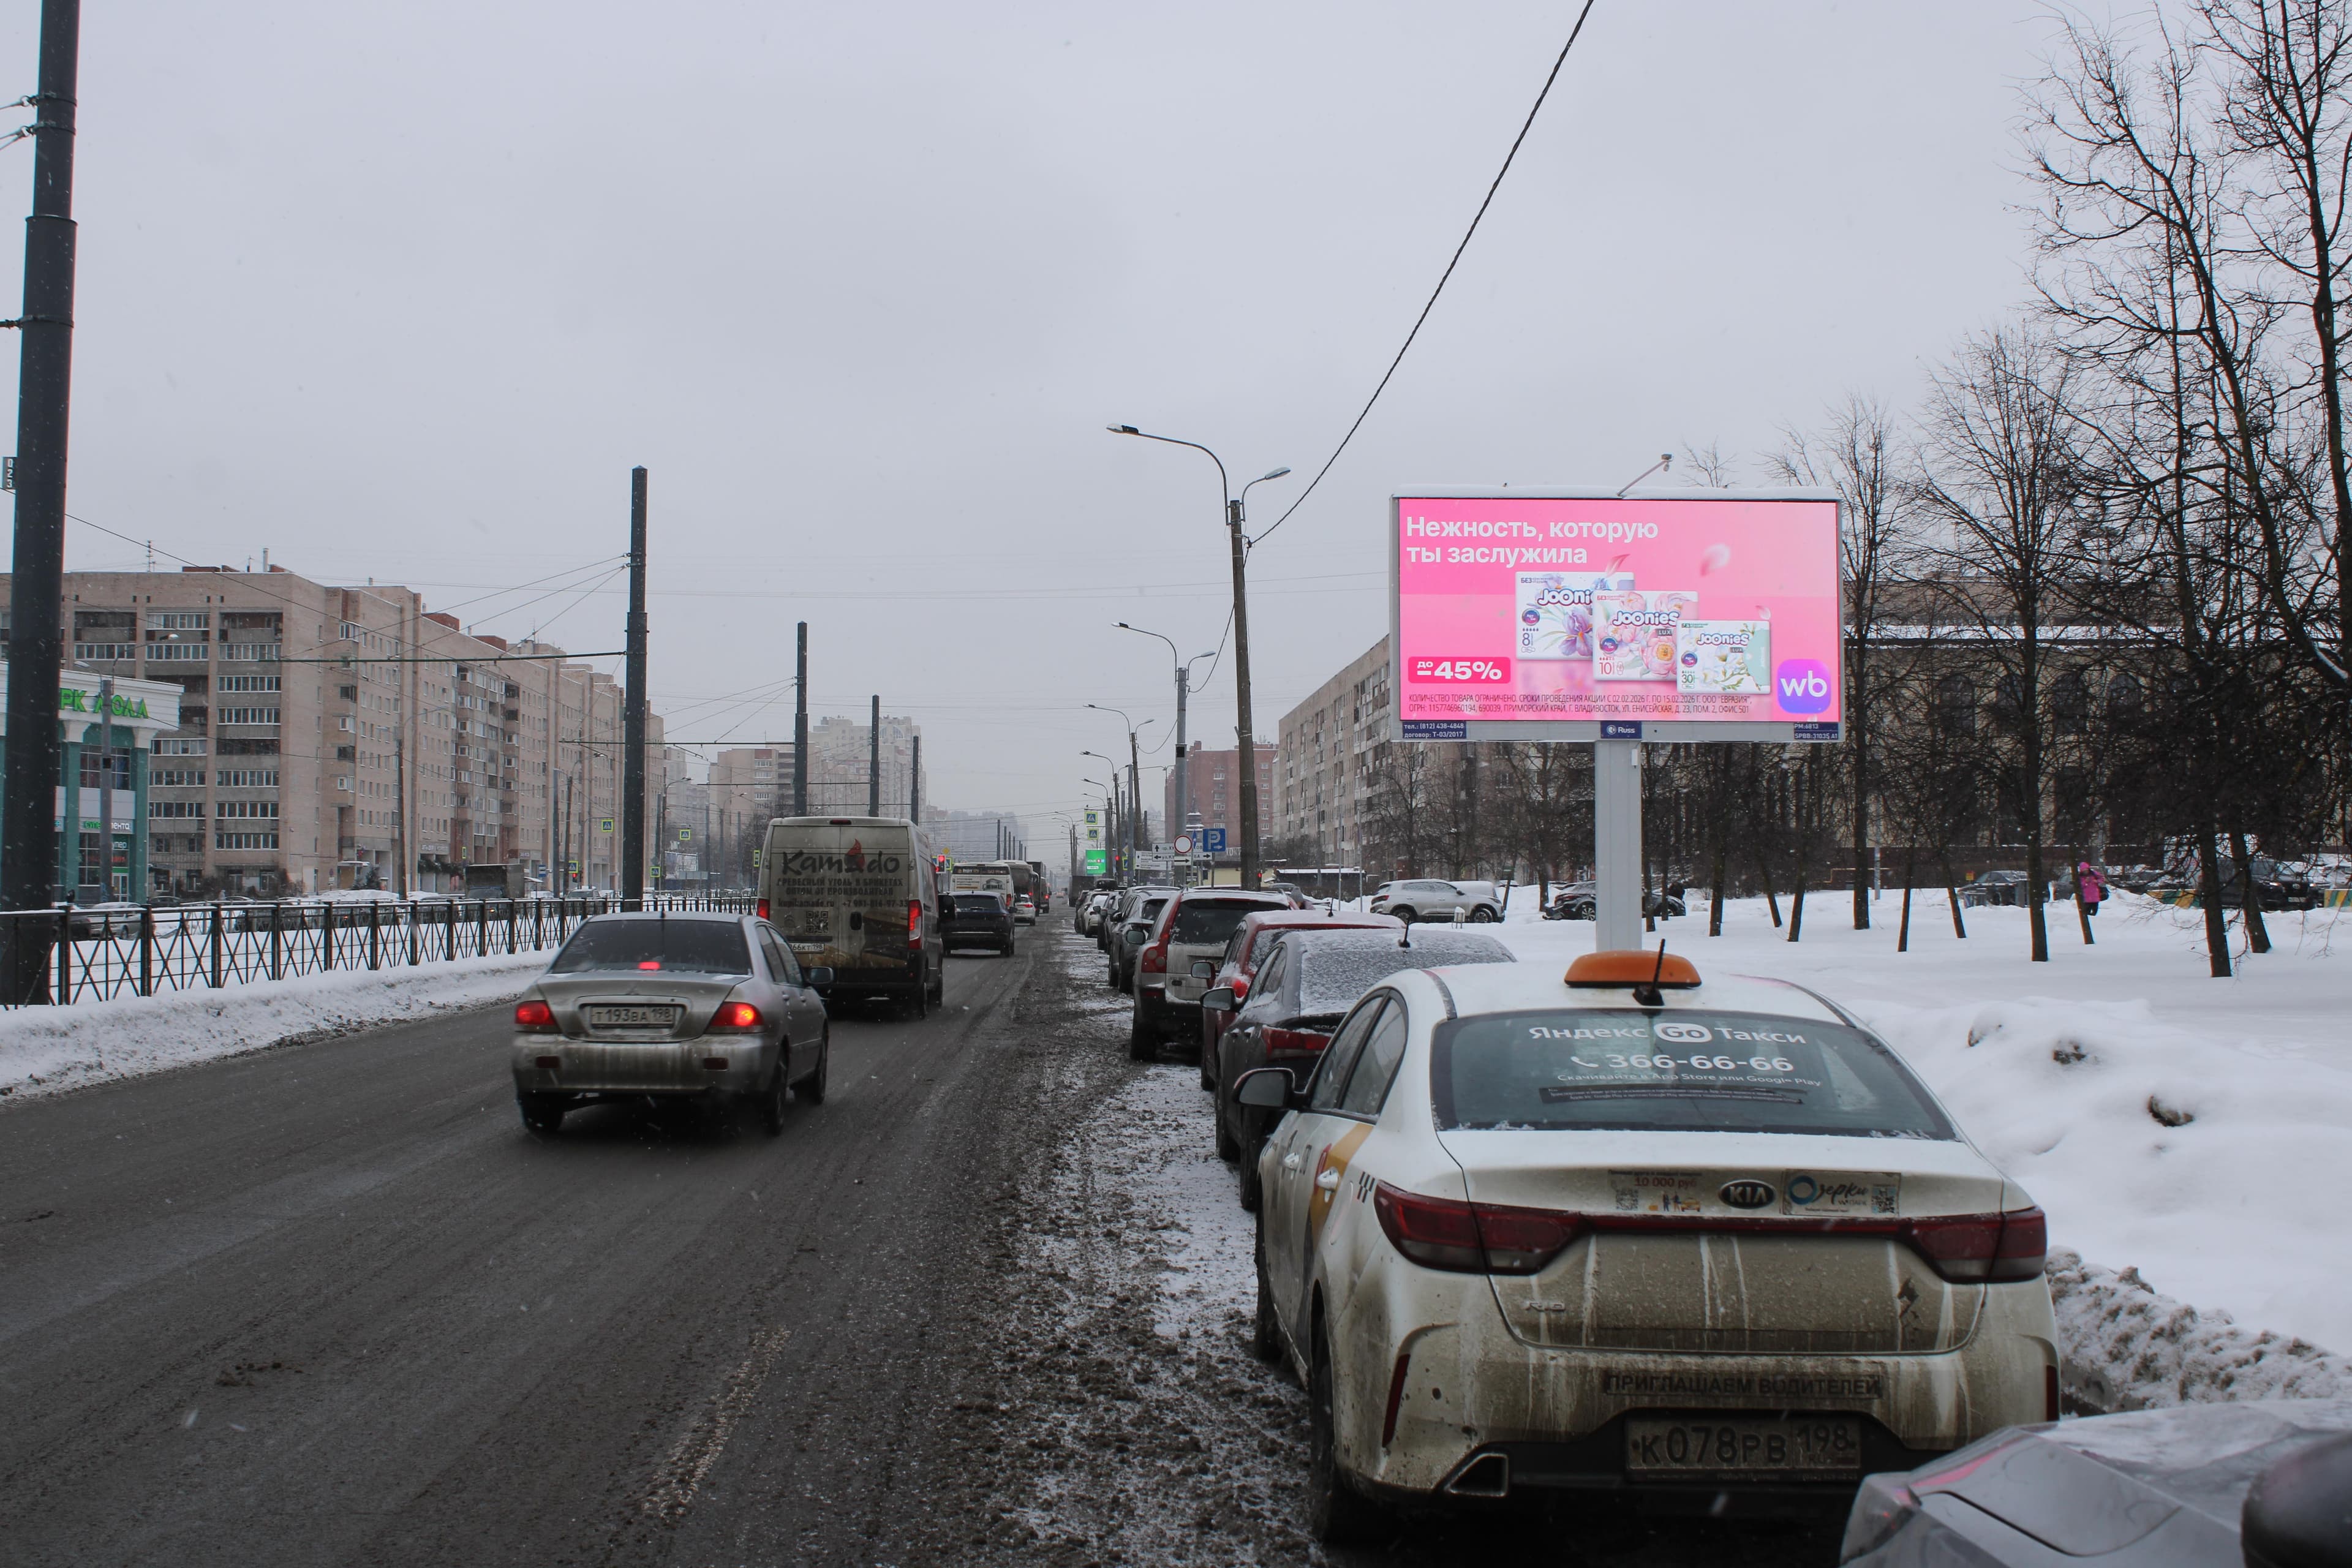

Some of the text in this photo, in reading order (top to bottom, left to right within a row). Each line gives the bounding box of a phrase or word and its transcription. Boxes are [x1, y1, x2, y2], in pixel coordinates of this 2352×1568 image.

[1406, 516, 1658, 543] Нежность, которую
[1406, 547, 1588, 568] ты заслужила
[1522, 632, 1530, 646] 8
[1599, 662, 1613, 674] 10
[1681, 674, 1694, 684] 30
[1779, 670, 1828, 698] wb
[59, 687, 87, 712] РК
[1409, 694, 1449, 703] КОЛИЧЕСТВО
[1451, 694, 1474, 703] ТОВАРА
[1475, 694, 1517, 703] ОГРАНИЧЕНО.
[1519, 694, 1540, 703] СРОКИ
[1541, 695, 1583, 704] ПРОВЕДЕНИЯ
[1584, 695, 1606, 704] АКЦИИ
[1607, 695, 1611, 703] С
[1612, 695, 1645, 703] 02.02.2026
[1702, 695, 1717, 704] ООО
[1428, 704, 1477, 713] 1157746960194,
[1479, 704, 1502, 713] 690039,
[1504, 703, 1549, 712] ПРИМОРСКИЙ
[1550, 703, 1568, 713] КРАЙ,
[1575, 704, 1620, 714] ВЛАДИВОСТОК,
[1632, 704, 1673, 714] ЕНИСЕЙСКАЯ,
[1675, 705, 1680, 714] Д.
[1682, 705, 1691, 714] 23,
[1718, 705, 1738, 714] ОФИС
[1738, 705, 1749, 714] 501
[84, 821, 100, 829] супе
[785, 887, 815, 896] ОПТОМ
[595, 1008, 671, 1022] Т193ВА 198
[1529, 1025, 1807, 1044] Яндекс Go Такси
[1607, 1054, 1795, 1072] 366-66-66
[1557, 1072, 1639, 1083] Скачивайте
[1652, 1073, 1679, 1083] App
[1681, 1072, 1717, 1082] Store
[1747, 1074, 1792, 1087] Google
[1793, 1077, 1823, 1087] Play
[1635, 1177, 1649, 1187] 10
[1652, 1177, 1675, 1188] 000
[1728, 1185, 1769, 1205] KIA
[1758, 1376, 1878, 1398] ВОДИТЕЛЕЙ
[1640, 1424, 1850, 1465] К078РВ 198
